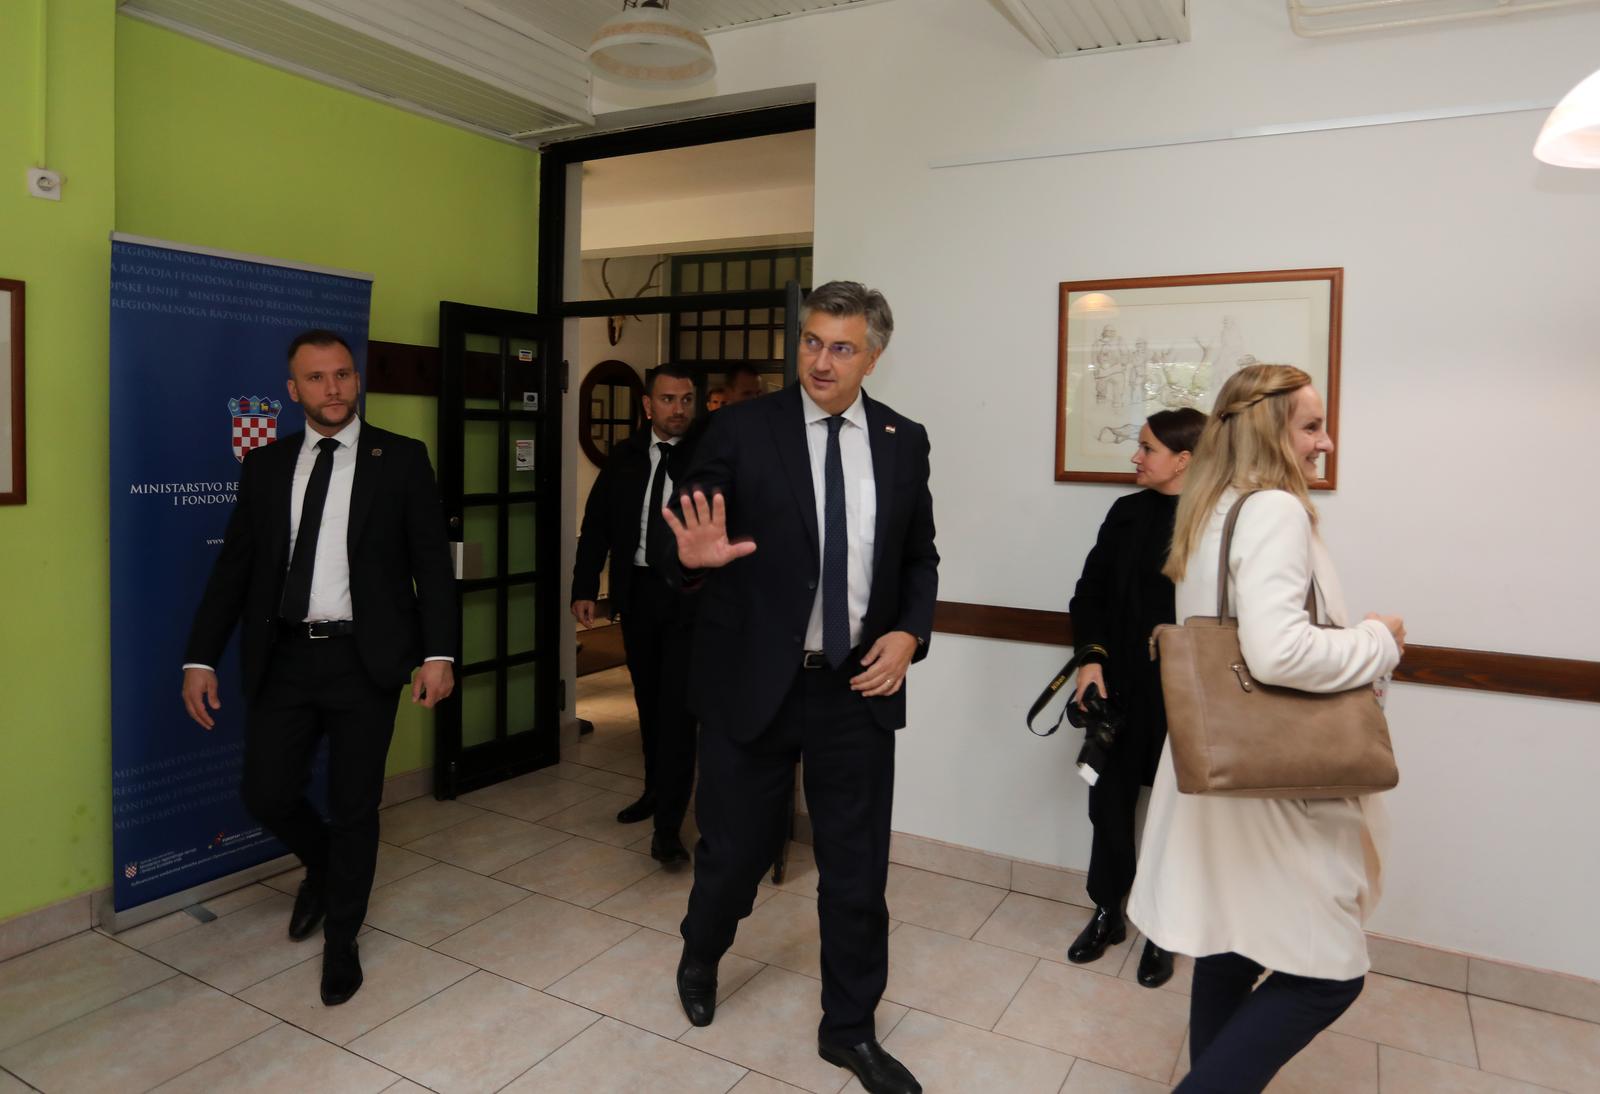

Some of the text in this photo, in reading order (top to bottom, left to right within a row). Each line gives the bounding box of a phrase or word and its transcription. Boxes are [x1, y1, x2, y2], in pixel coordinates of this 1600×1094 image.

[121, 263, 172, 280] RAZVOJA
[181, 271, 234, 288] FONDOVA
[146, 284, 178, 297] UNIJE
[186, 289, 264, 309] MINISTARSTVO
[111, 298, 206, 317] REGIONALNOGA
[209, 309, 253, 322] RAZVOJA
[130, 481, 239, 494] MINISTARSTVO RE
[174, 494, 238, 506] I FONDOVA
